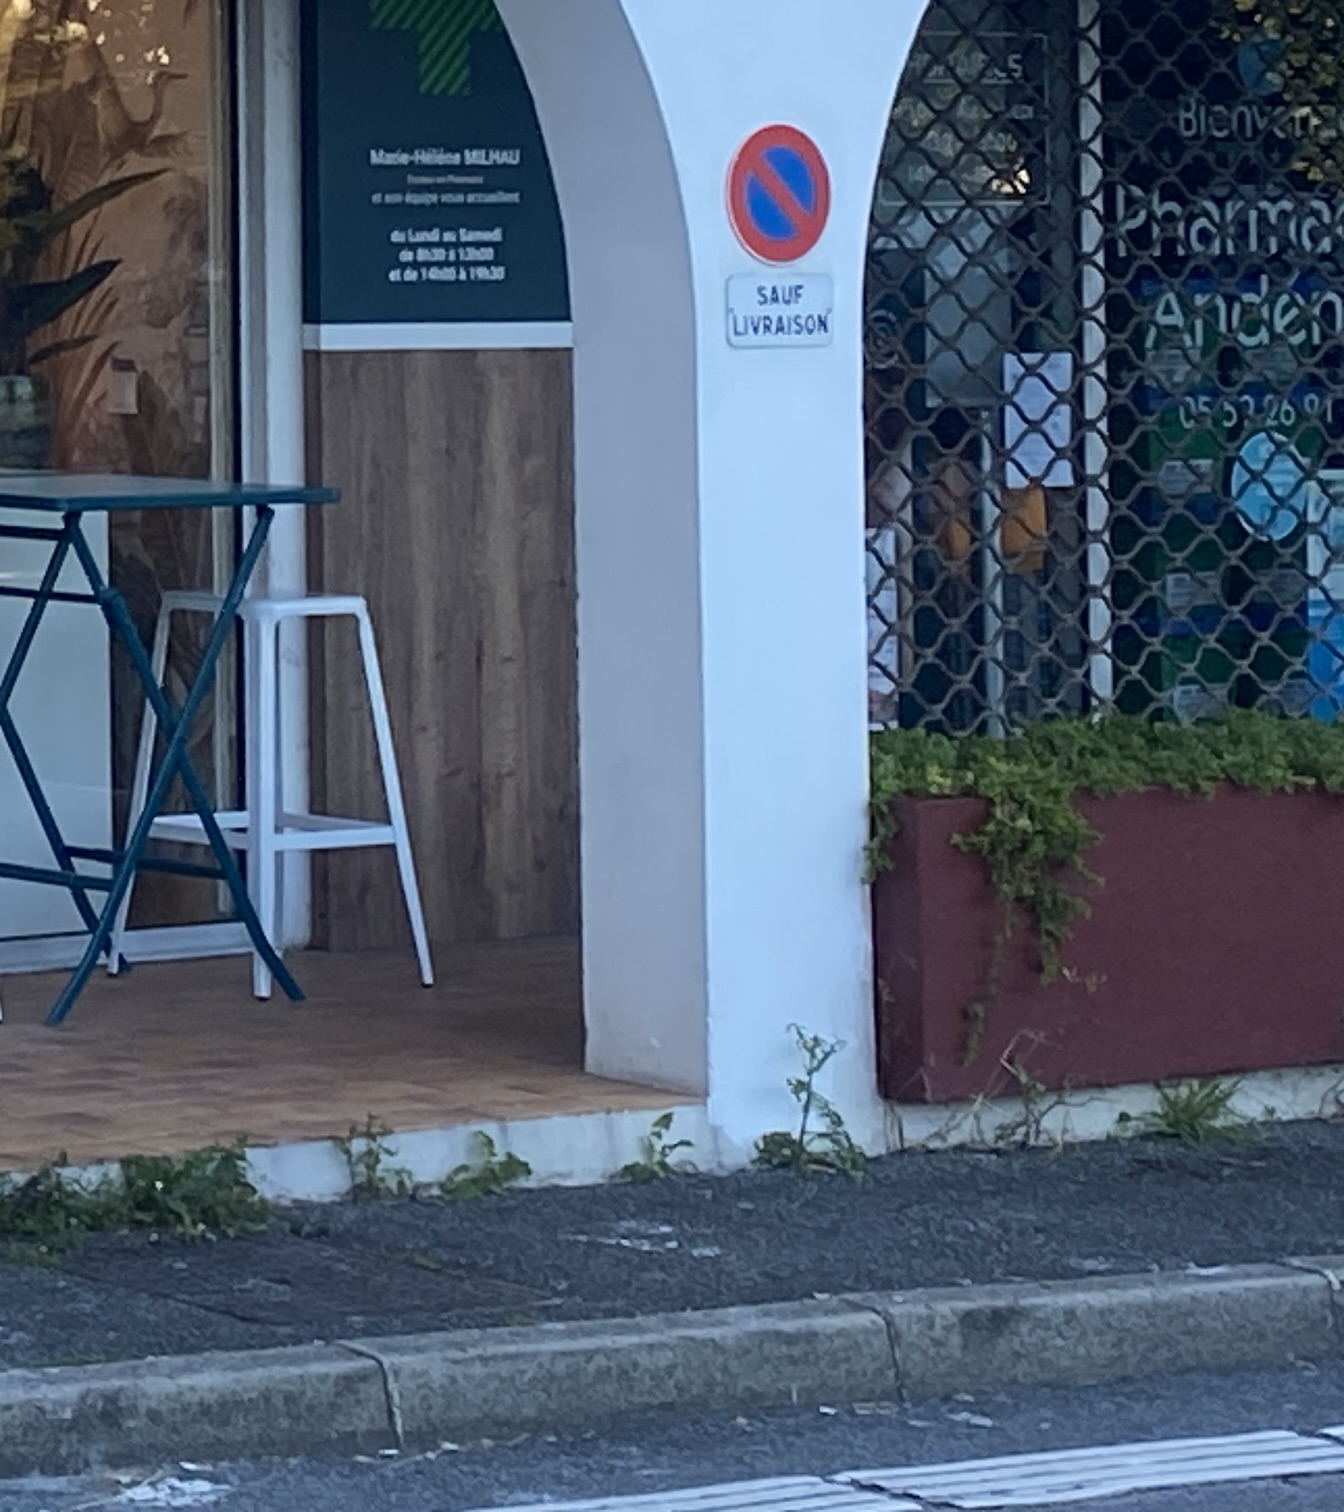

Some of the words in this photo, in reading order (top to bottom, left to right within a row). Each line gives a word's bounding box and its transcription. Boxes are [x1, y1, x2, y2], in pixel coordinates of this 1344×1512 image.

[464, 149, 521, 166] MILHAU
[1115, 184, 1344, 256] Pharma
[390, 228, 406, 243] du
[407, 228, 440, 243] Lundi
[442, 230, 457, 243] au
[459, 228, 503, 243] Samedi
[398, 248, 414, 262] de
[388, 268, 402, 282] et
[403, 267, 418, 282] de
[756, 284, 804, 306] SAUF
[732, 313, 829, 337] LIVRAISON
